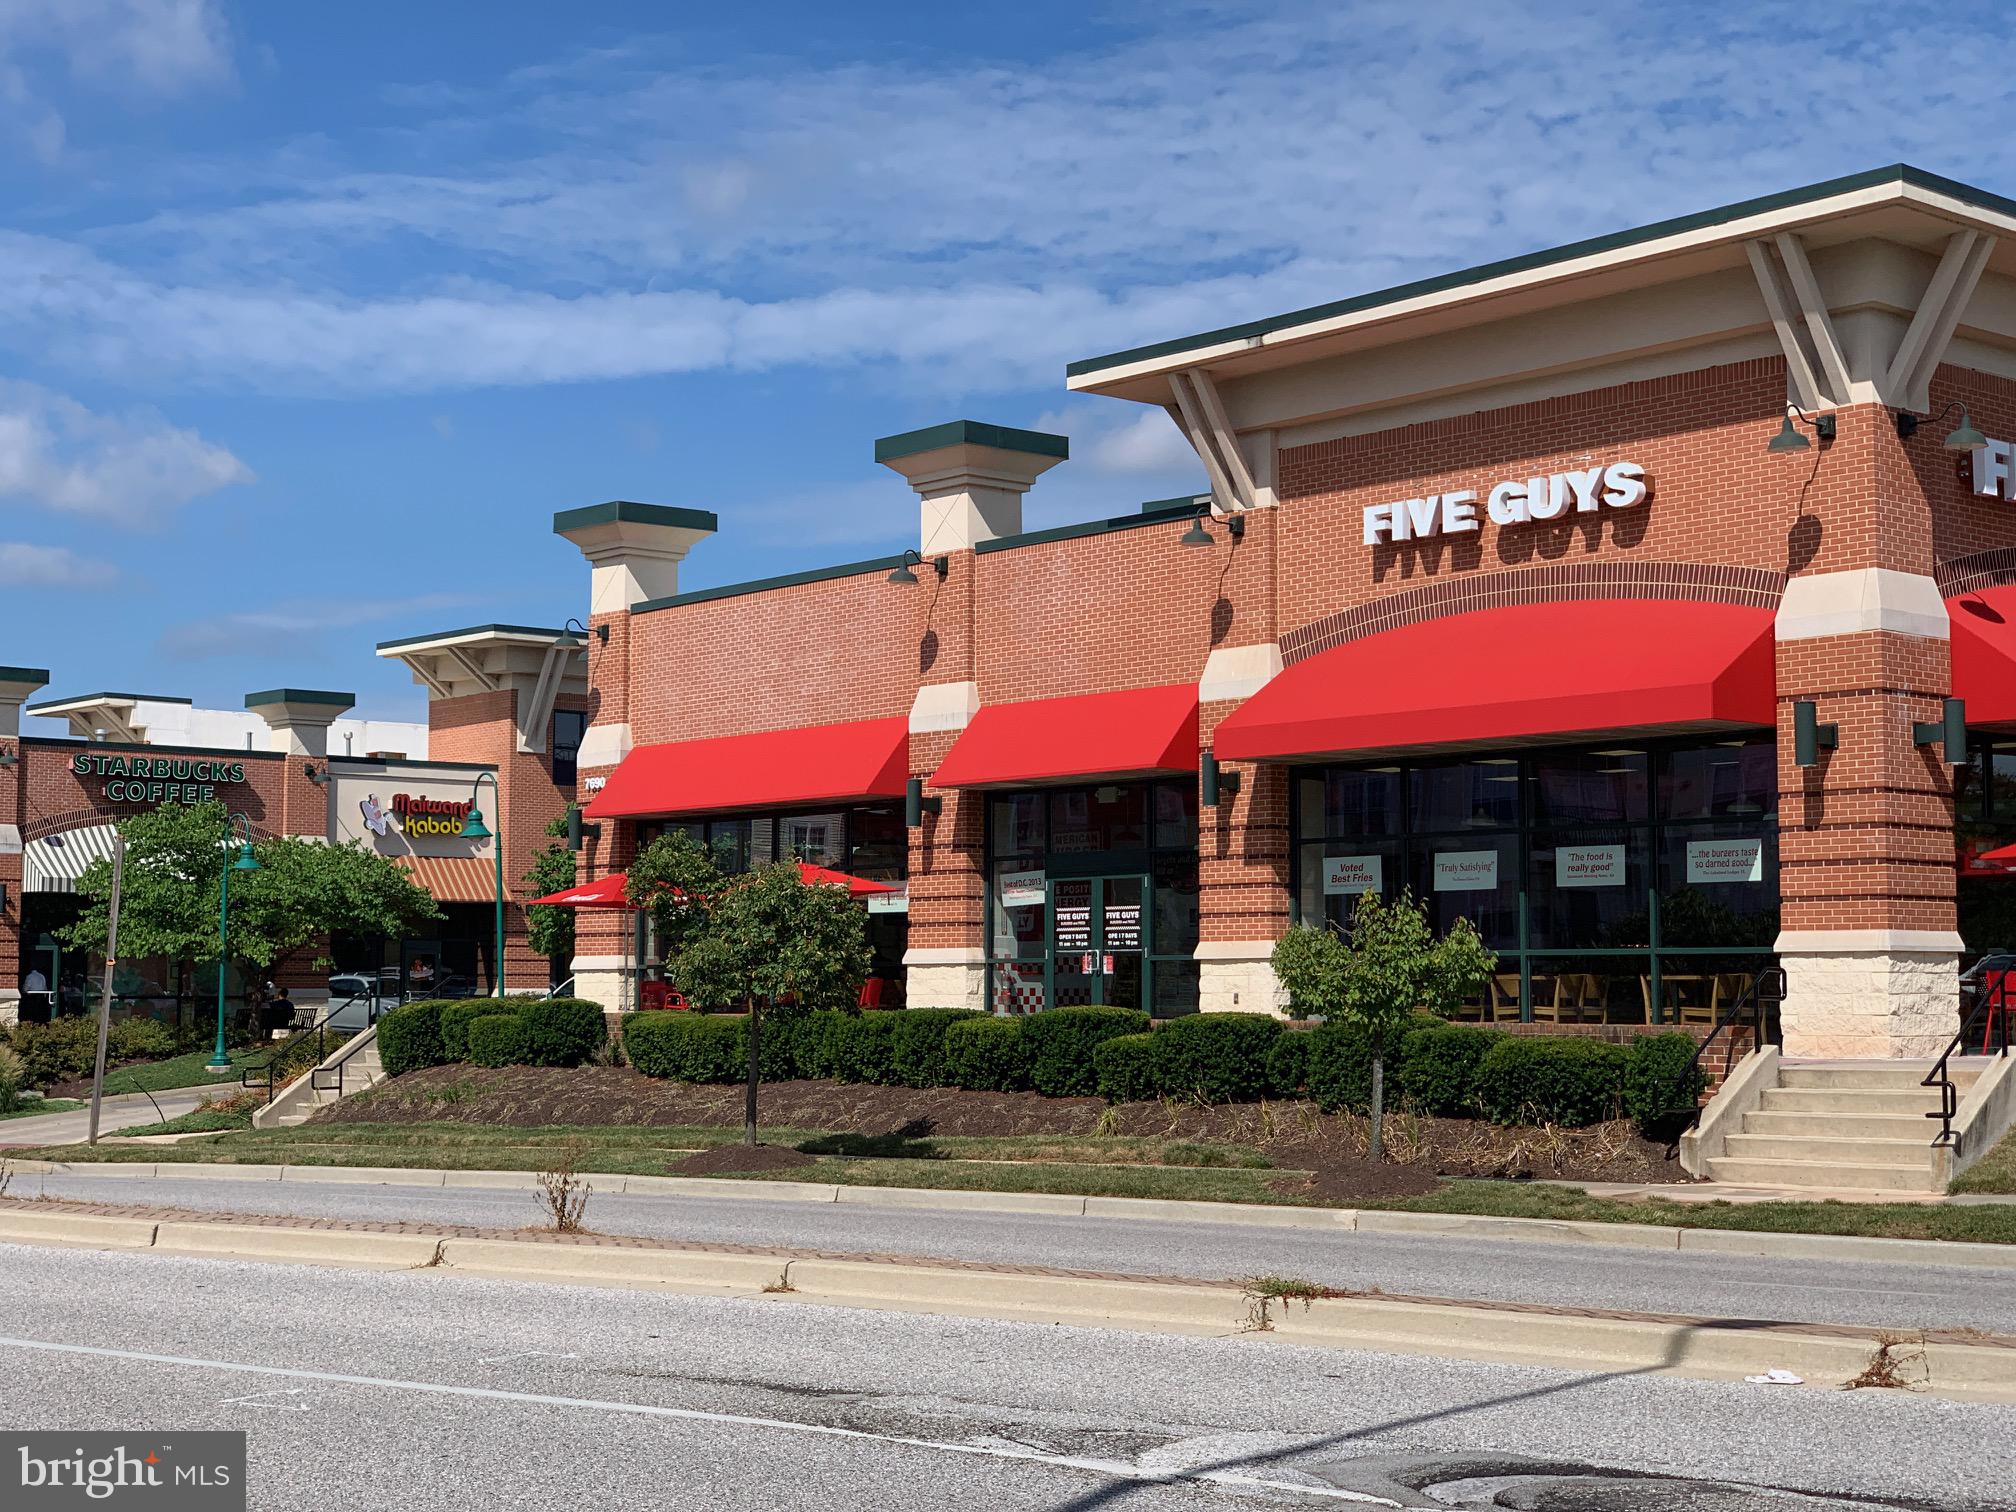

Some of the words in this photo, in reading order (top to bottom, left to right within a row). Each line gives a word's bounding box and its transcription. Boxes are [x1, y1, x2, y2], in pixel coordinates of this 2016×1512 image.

[1362, 489, 1479, 545] FIVE
[1487, 461, 1647, 526] GUYS
[73, 752, 247, 783] STARBUCKS
[584, 776, 606, 790] 7690
[106, 780, 215, 804] COFFEE
[392, 793, 477, 818] Maiwand
[1586, 852, 1605, 862] food
[1711, 847, 1739, 858] burgers
[1741, 847, 1759, 857] taste
[1340, 863, 1364, 873] Voted
[1567, 863, 1589, 873] really
[1695, 861, 1704, 869] so
[1705, 859, 1730, 869] darned
[1331, 874, 1351, 884] Best
[1352, 873, 1374, 883] Fries
[1057, 912, 1072, 921] FIVE
[1072, 912, 1090, 920] GUYS
[1106, 911, 1121, 920] FIVE
[1121, 911, 1140, 919] GUYS
